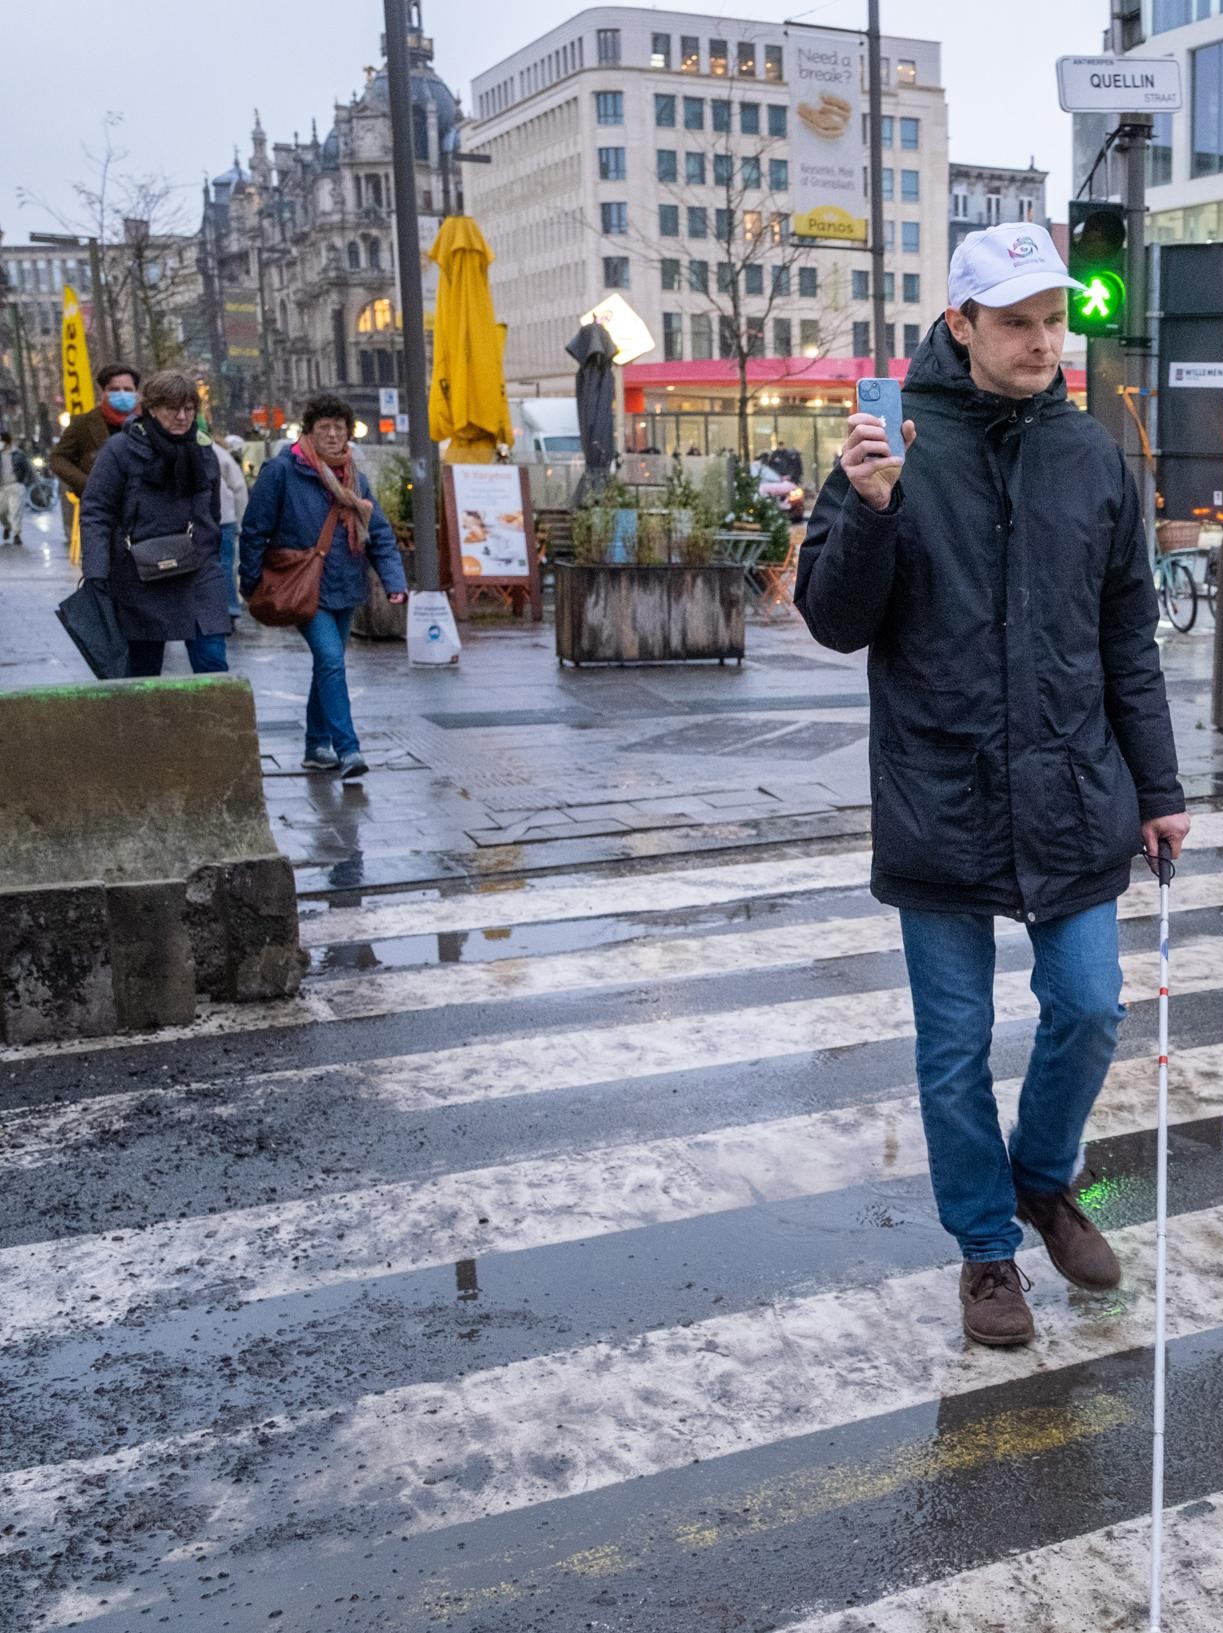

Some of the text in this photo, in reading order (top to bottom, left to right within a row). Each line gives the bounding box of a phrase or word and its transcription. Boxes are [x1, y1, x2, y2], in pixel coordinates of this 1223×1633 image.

[797, 47, 852, 68] Need a
[798, 63, 853, 84] break?
[1089, 73, 1155, 89] QUELLIN
[1143, 93, 1177, 103] STRAAT
[807, 218, 854, 234] Panos
